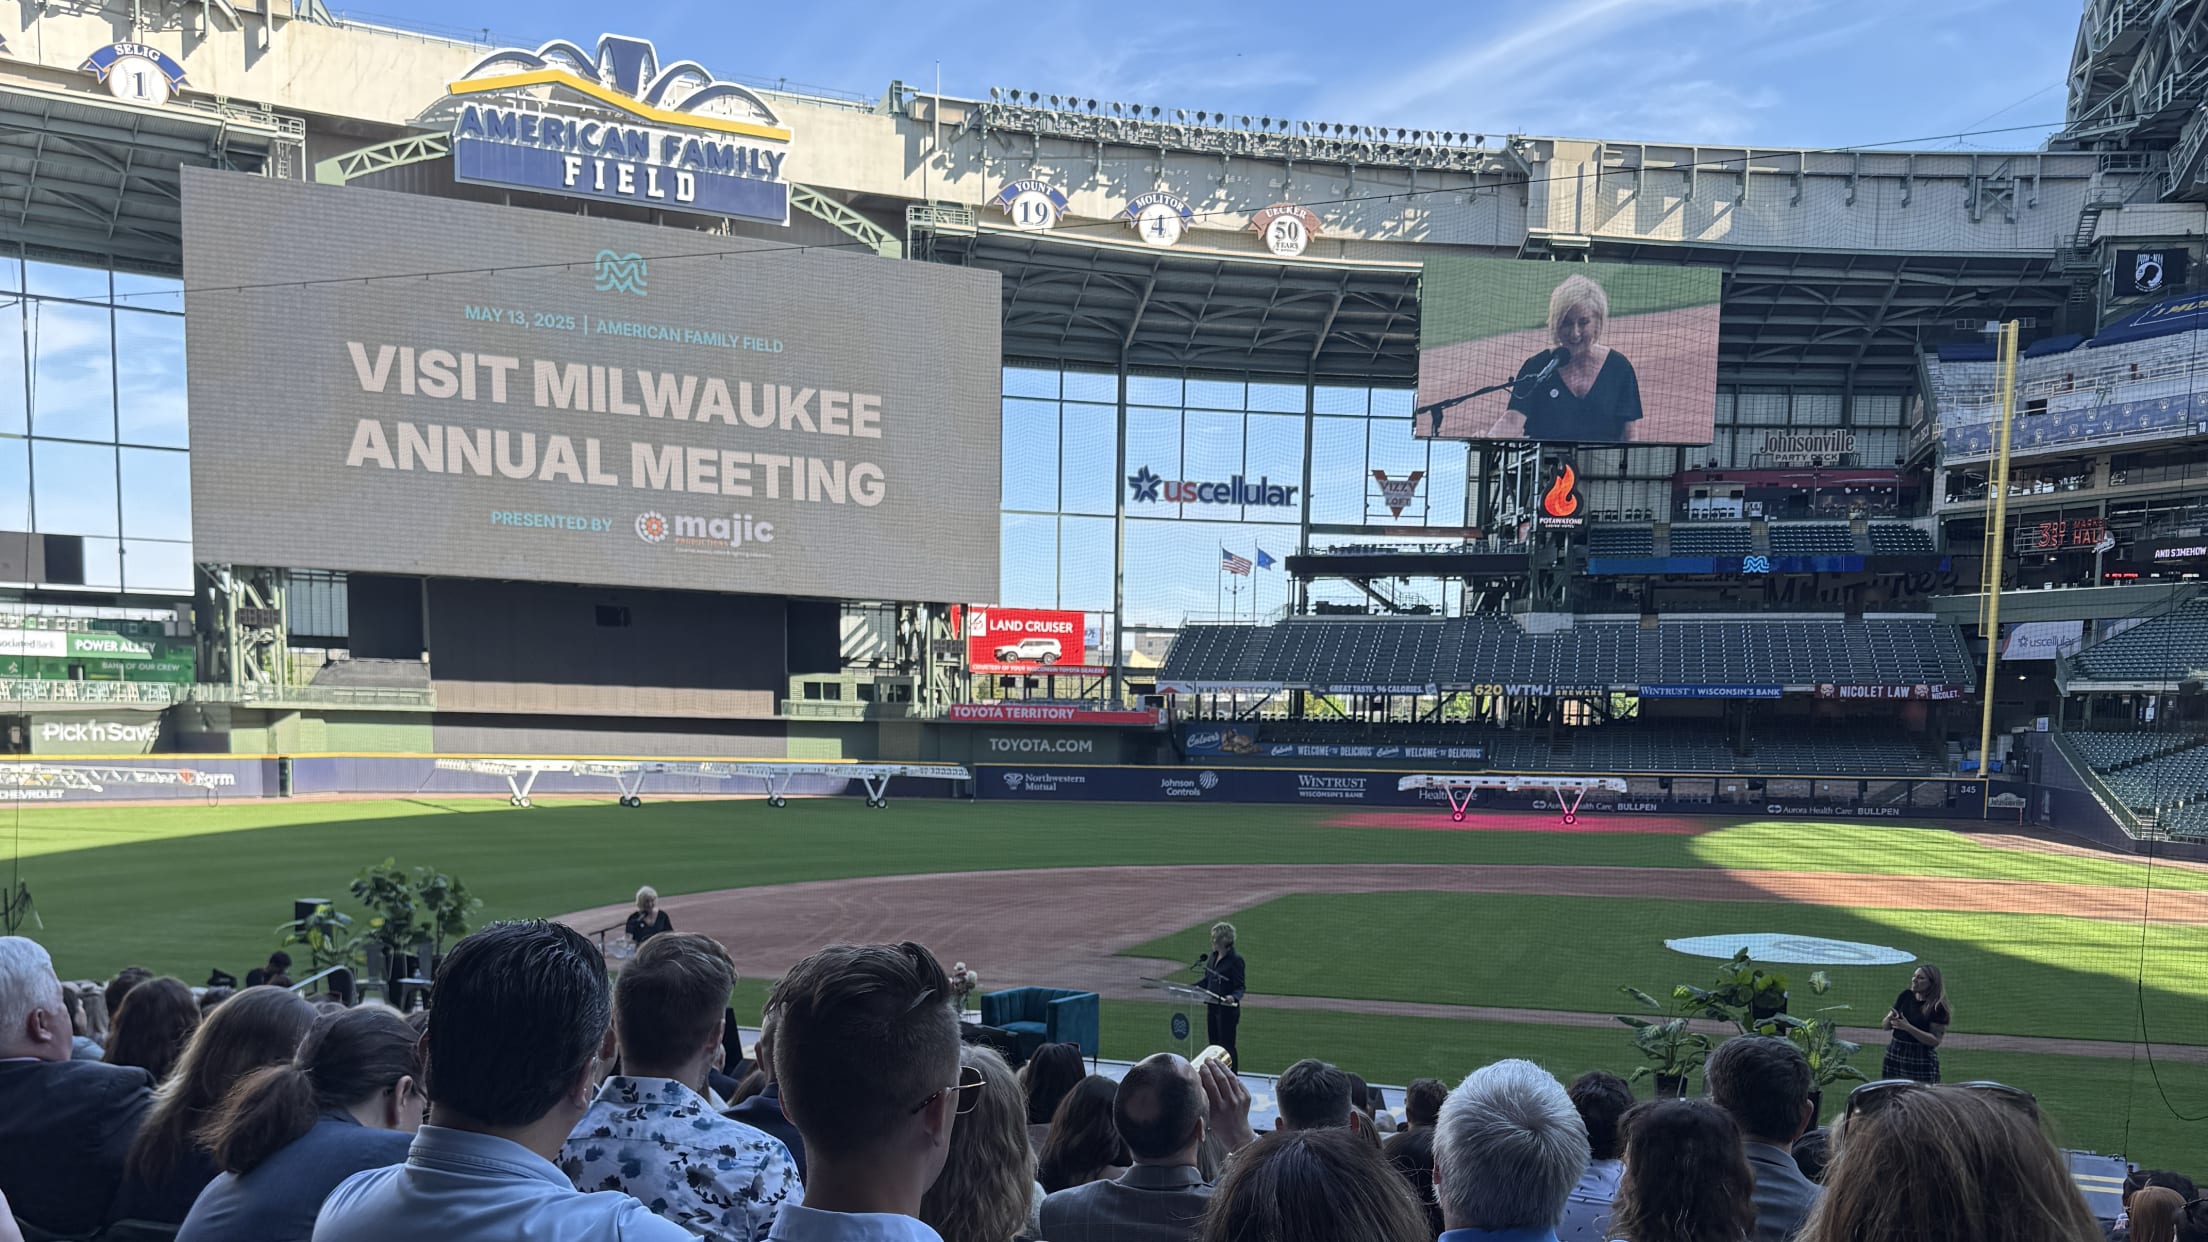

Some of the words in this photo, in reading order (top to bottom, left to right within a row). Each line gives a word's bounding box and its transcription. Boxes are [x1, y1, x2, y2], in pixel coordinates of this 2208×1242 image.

[114, 43, 160, 61] SELIG
[133, 72, 150, 100] 1
[459, 104, 650, 161] AMERICAN
[664, 135, 785, 179] FAMILY
[563, 156, 695, 202] FIELD
[1015, 181, 1054, 196] YOUNT
[1135, 194, 1186, 211] MOLITOR
[1019, 200, 1048, 226] 19
[1266, 206, 1308, 219] UECKER
[1149, 214, 1166, 238] 4
[1274, 222, 1299, 243] 50
[464, 304, 502, 321] MAY
[507, 310, 529, 328] 13,
[534, 313, 576, 331] 2025
[596, 319, 681, 343] AMERICAN
[684, 329, 739, 350] FAMILY
[743, 337, 784, 353] FIELD
[347, 341, 519, 404] VISIT
[533, 359, 883, 439] MILWAUKEE
[1760, 429, 1856, 453] Johnsonville
[346, 418, 619, 487] ANNUAL
[631, 441, 886, 507] MEETING
[1811, 453, 1838, 461] DECK
[1163, 474, 1299, 507] uscellular
[1380, 481, 1418, 493] VIZZY
[1386, 498, 1411, 507] LOFT
[490, 511, 588, 531] PRESENTED
[591, 517, 613, 533] BY
[674, 513, 775, 548] majic
[2154, 549, 2170, 559] AND
[2170, 546, 2207, 557] SOMEHOW
[989, 619, 1023, 632] LAND
[1025, 620, 1074, 634] CRUISER
[75, 639, 117, 651] POWER
[120, 640, 156, 653] ALLEY
[2029, 634, 2076, 647] uscellular
[139, 663, 155, 671] OUR
[156, 663, 181, 672] CREW
[1329, 684, 1352, 693] GREAT
[1353, 685, 1375, 693] TASTE.
[1377, 685, 1387, 693] 96
[1388, 685, 1424, 693] CALORIES.
[1474, 684, 1503, 696] 620
[1506, 684, 1552, 696] WTMJ
[1640, 685, 1690, 696] WINTRUST
[1697, 687, 1754, 696] WISCONSIN'S
[1756, 688, 1781, 696] BANK
[1840, 685, 1884, 698] NICOLET
[1887, 686, 1910, 698] LAW
[1931, 684, 1943, 693] GET
[954, 706, 1003, 718] TOYOTA
[1006, 706, 1075, 719] TERRITORY
[989, 738, 1093, 753] TOYOTA.COM
[1297, 746, 1329, 756] WELCOME
[1340, 747, 1373, 757] DELICIOUS
[1405, 747, 1437, 758] WELCOME
[1448, 748, 1481, 758] DELICIOUS
[1024, 773, 1086, 784] Northwestern
[1160, 778, 1195, 788] Johnson
[1298, 774, 1367, 787] WINTRUST
[1024, 782, 1057, 791] Mutual
[1166, 788, 1201, 796] Controls
[1960, 785, 1977, 794] 345
[1617, 803, 1657, 811] BULLPEN
[1783, 806, 1808, 814] Aurora
[1809, 806, 1833, 815] Health
[1834, 807, 1853, 815] Care
[1857, 807, 1900, 815] BULLPEN
